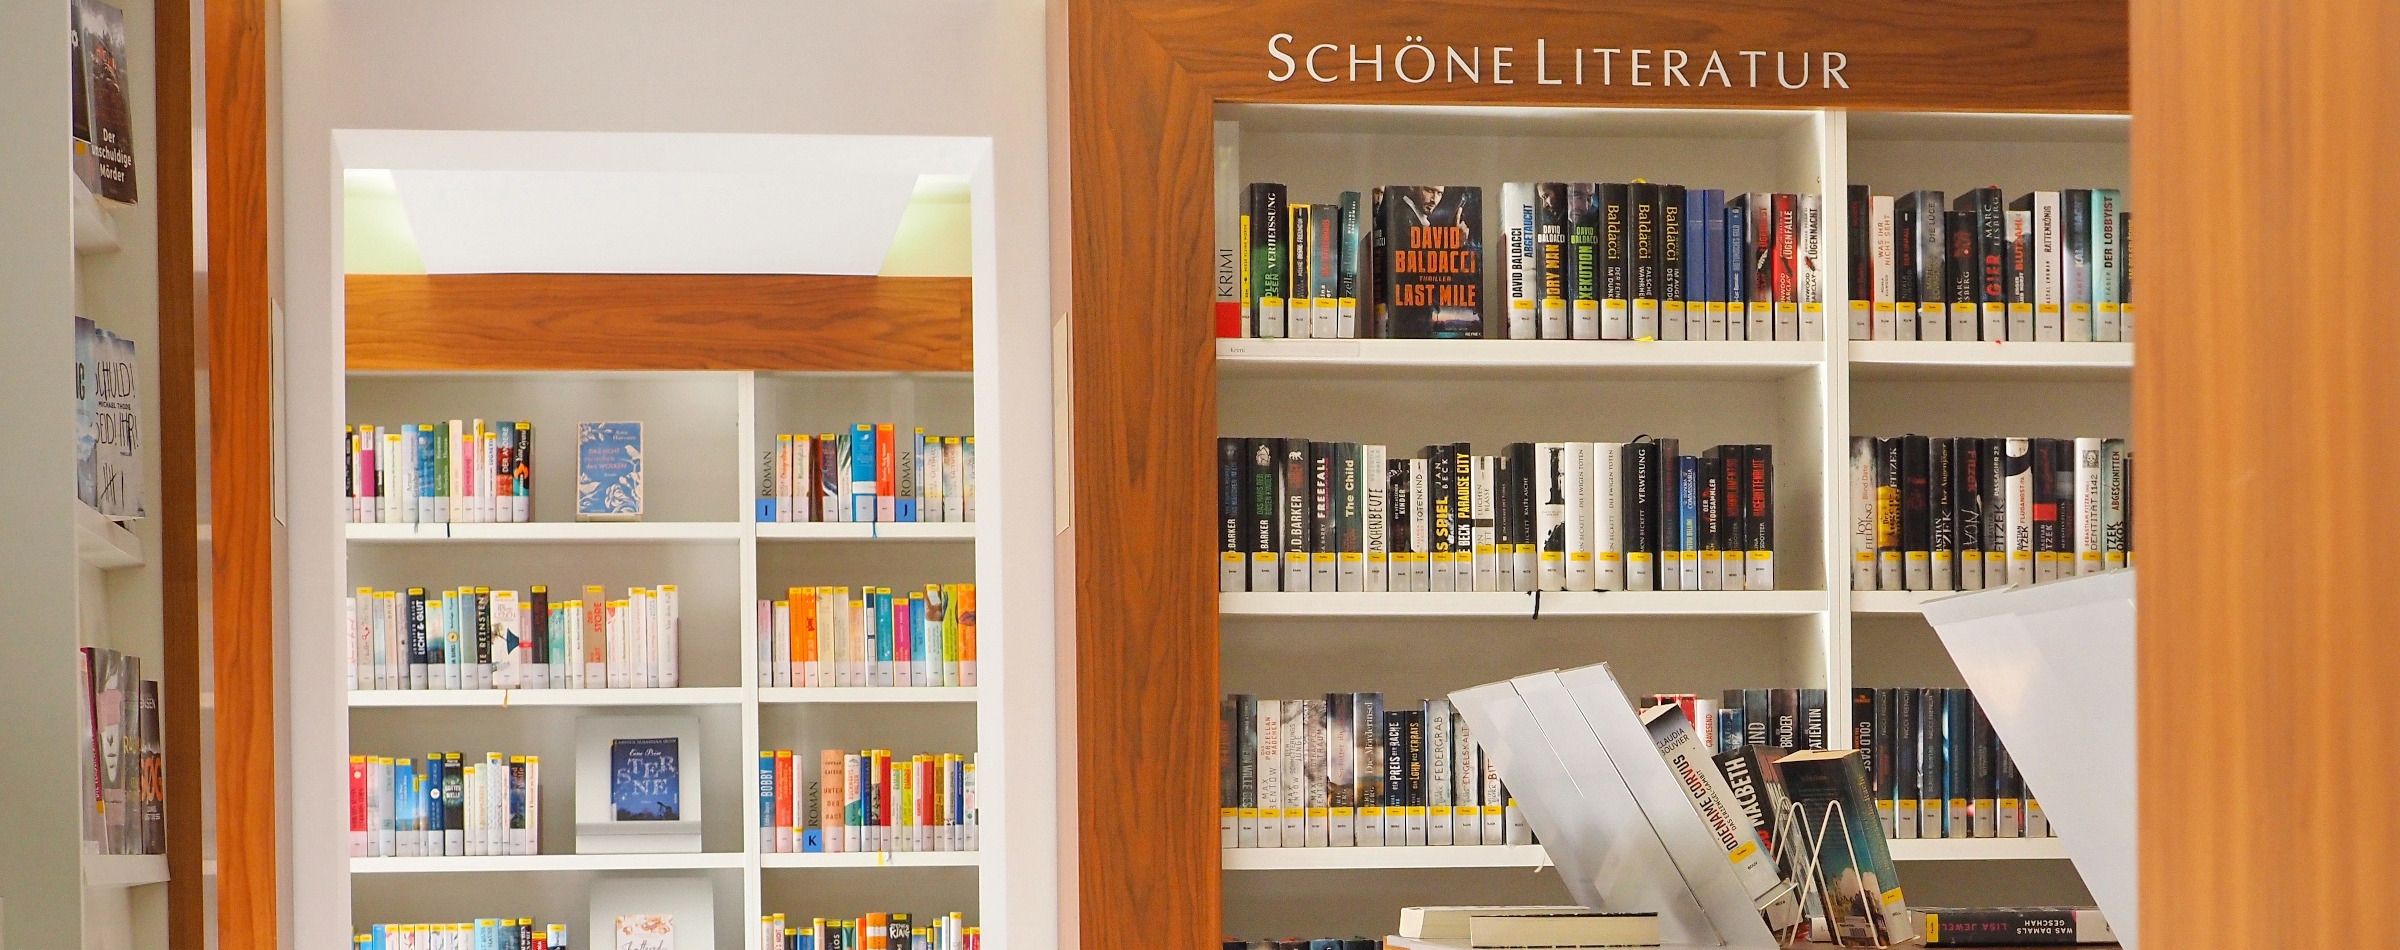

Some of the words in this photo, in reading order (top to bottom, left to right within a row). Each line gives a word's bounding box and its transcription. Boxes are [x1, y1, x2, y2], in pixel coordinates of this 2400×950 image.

[1266, 31, 1516, 86] SCHÖNE
[1536, 37, 1850, 90] LITERATUR
[103, 127, 116, 145] Der
[100, 163, 125, 183] Mörder
[1268, 192, 1277, 268] VERHEISSUNG
[1523, 204, 1534, 258] ABGETAUCHT
[1543, 225, 1560, 234] DAVID
[1577, 226, 1594, 235] DAVID
[1608, 204, 1620, 260] Baldacci
[1638, 204, 1651, 258] Baldacci
[1666, 206, 1678, 262] Baldacci
[1782, 210, 1792, 260] LÜGENFALLE
[1808, 208, 1818, 260] LÜGENNACHT
[1984, 204, 1992, 238] MARC
[2042, 206, 2052, 253] RATTENKÖNIG
[2104, 196, 2113, 245] LOBBYIST
[1410, 226, 1460, 249] DAVID
[1512, 228, 1522, 271] BALDACCI
[1538, 234, 1565, 243] BALDACCI
[1571, 234, 1598, 244] BALDACCI
[1395, 250, 1477, 274] BALDACCI
[1546, 244, 1560, 268] MAN
[1608, 266, 1614, 276] IM
[2104, 248, 2113, 268] DER
[1218, 248, 1234, 298] KRIMI
[1512, 273, 1523, 298] DAVID
[1674, 268, 1680, 278] IM
[1395, 284, 1434, 307] LAST
[1440, 284, 1477, 307] MILE
[1456, 453, 1470, 474] CITY
[1994, 445, 2000, 455] 23
[761, 450, 772, 496] ROMAN
[900, 451, 910, 496] ROMAN
[1346, 460, 1354, 491] Child
[1890, 447, 1898, 488] FITZEK
[1967, 450, 1976, 492] FITZEK
[2111, 450, 2120, 511] ABGESCHNITTEN
[1316, 458, 1325, 518] FREEFALL
[1457, 476, 1470, 518] PARADISE
[1346, 495, 1354, 518] The
[1436, 495, 1448, 537] SPIEL
[1458, 524, 1470, 546] BECK
[1856, 518, 1864, 534] JOY
[1862, 503, 1872, 550] FIELDING
[1994, 504, 2004, 552] FITZEK
[2107, 524, 2116, 550] TZEK
[416, 600, 425, 622] GLUT
[416, 622, 424, 630] &
[478, 597, 487, 648] REINSTEN
[594, 602, 602, 632] STORE
[416, 631, 425, 655] LICHT
[1364, 702, 1374, 754] Mörderinsel
[1389, 722, 1401, 746] RACHE
[1410, 722, 1422, 753] VERRATS
[1656, 727, 1685, 748] CLAUDIA
[1748, 722, 1766, 744] IND
[1780, 716, 1793, 748] BRUDER
[1860, 721, 1871, 746] COLD
[1434, 716, 1444, 780] FEDERGRAB
[1461, 726, 1470, 785] ENGELSKALT
[1364, 758, 1374, 774] Die
[1390, 756, 1402, 780] PREIS
[1409, 761, 1420, 780] LOHN
[1672, 753, 1707, 798] CORVUS
[760, 768, 773, 798] BOBBY
[1696, 769, 1732, 821] ERZENGEL-GAMBIT
[1724, 755, 1765, 829] MACBETH
[808, 781, 818, 827] ROMAN
[1726, 818, 1738, 831] DAS
[808, 836, 816, 846] K
[890, 926, 910, 938] KING
[1983, 922, 2007, 930] LISA
[2016, 927, 2052, 935] DAMALS
